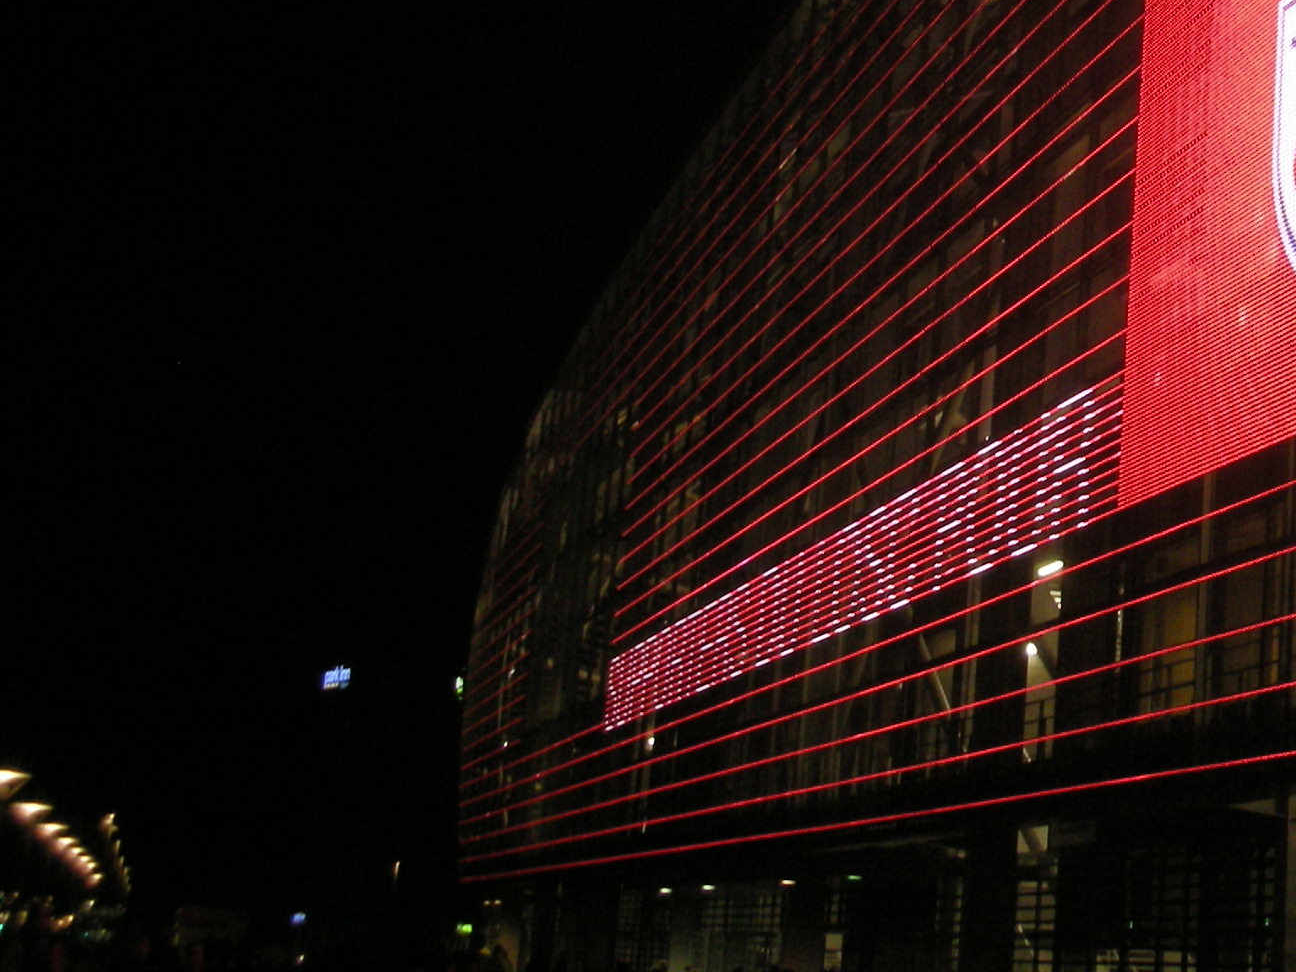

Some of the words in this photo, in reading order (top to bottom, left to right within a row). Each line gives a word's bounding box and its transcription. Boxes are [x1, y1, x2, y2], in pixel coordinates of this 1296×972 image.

[605, 580, 749, 730] SUPPORTERS
[756, 551, 800, 664] DU
[810, 484, 920, 641] LOSC
[934, 386, 1093, 588] POUR
